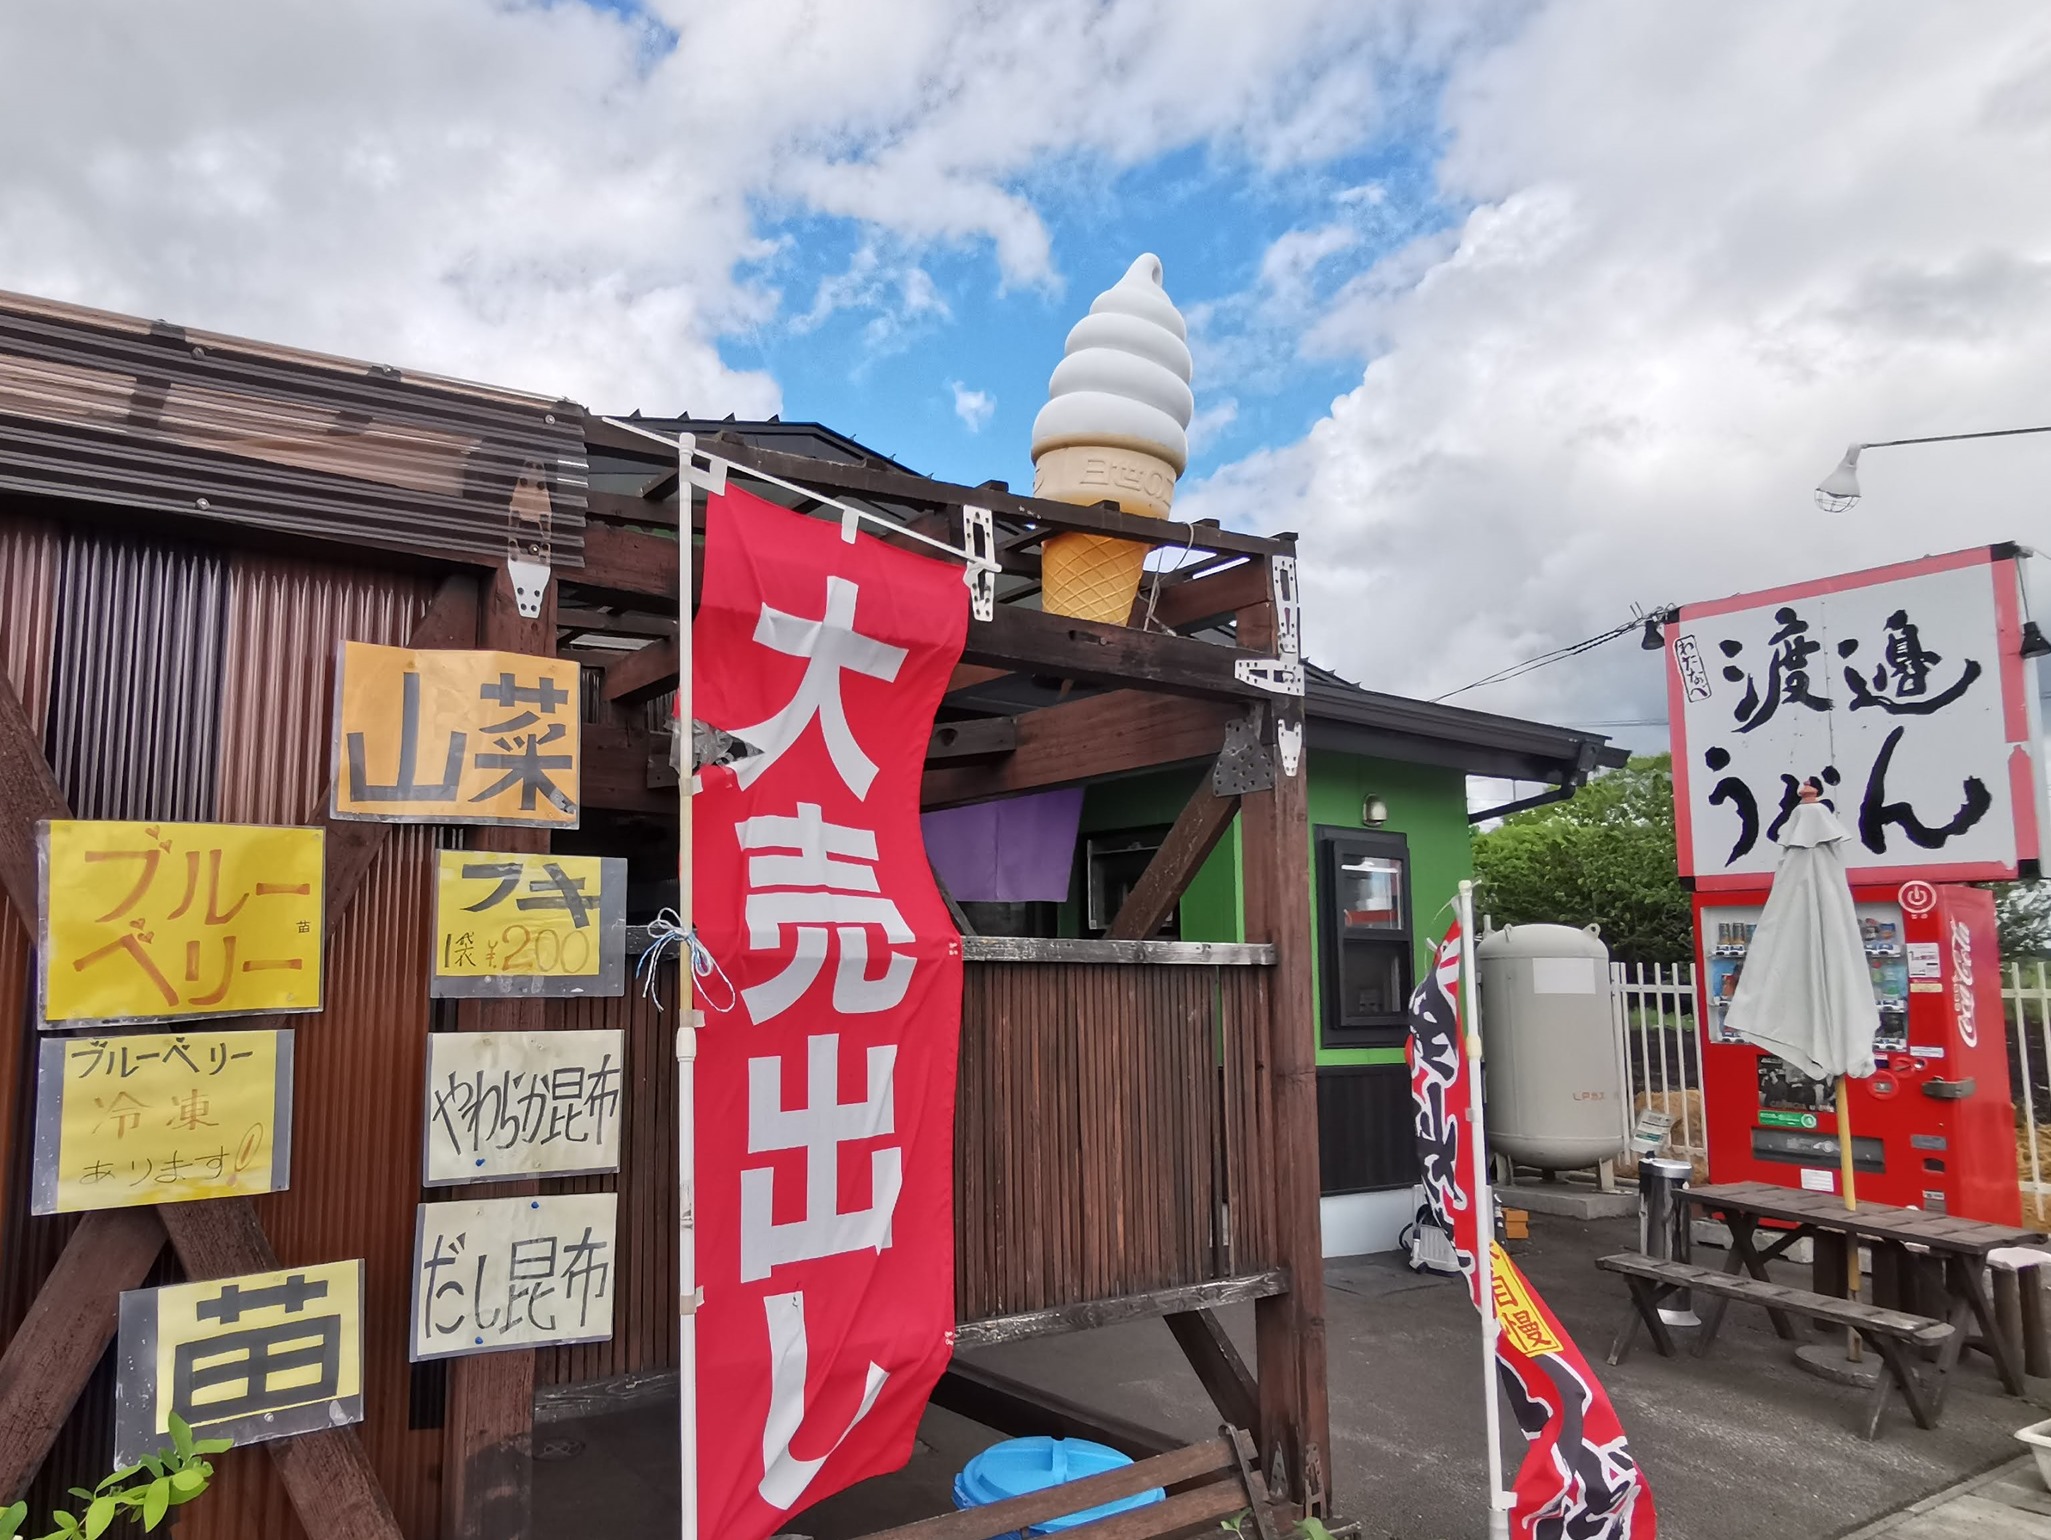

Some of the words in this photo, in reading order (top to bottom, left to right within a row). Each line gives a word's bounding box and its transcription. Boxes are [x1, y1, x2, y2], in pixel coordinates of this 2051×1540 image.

[1678, 639, 1708, 697] わたなべ
[347, 671, 577, 814] 山菜
[84, 826, 311, 926] ブルー
[461, 862, 602, 928] フキ
[73, 916, 303, 1007] ベリー
[295, 919, 312, 934] 苗
[71, 1036, 254, 1079] ブルーベリー
[727, 576, 914, 1510] 大売出し
[92, 1088, 220, 1140] 冷凍
[432, 1053, 622, 1156] やわらか昆布
[424, 1226, 611, 1339] だし昆布
[171, 1273, 342, 1428] 苗
